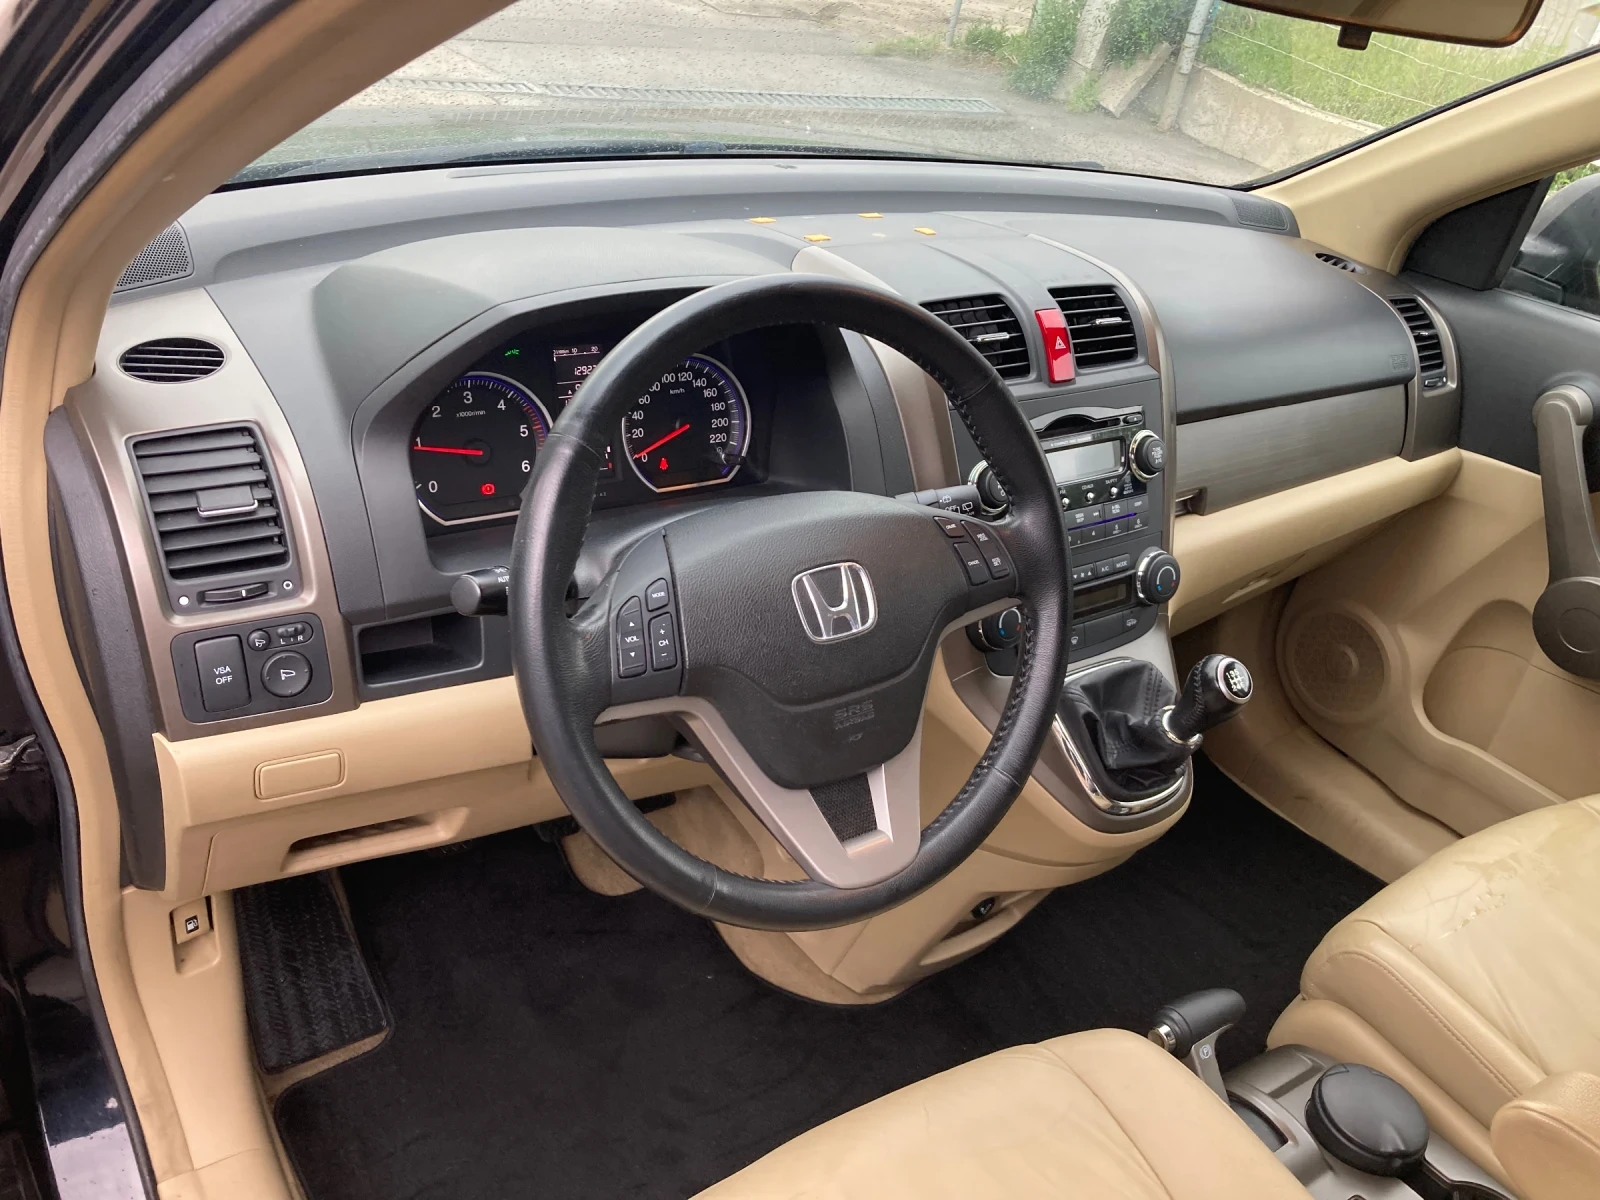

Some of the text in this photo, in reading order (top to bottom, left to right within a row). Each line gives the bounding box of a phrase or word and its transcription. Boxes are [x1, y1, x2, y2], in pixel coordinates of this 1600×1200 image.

[574, 364, 597, 375] 1292
[662, 373, 676, 383] 100
[678, 371, 693, 382] 120
[692, 377, 707, 388] 140
[669, 387, 686, 395] km/h
[703, 387, 718, 398] 160
[463, 391, 473, 404] 3
[497, 399, 506, 411] 4
[710, 402, 726, 412] 180
[431, 405, 442, 418] 2
[631, 410, 644, 421] 40
[711, 417, 729, 428] 200
[519, 424, 529, 437] 5
[631, 428, 644, 439] 20
[709, 432, 727, 444] 220
[641, 453, 648, 462] 0
[521, 459, 531, 473] 6
[428, 480, 439, 493] 0
[624, 635, 640, 643] VOL
[658, 638, 670, 647] CH
[213, 665, 232, 675] VSA
[215, 675, 233, 685] OFF
[834, 700, 874, 718] SRS
